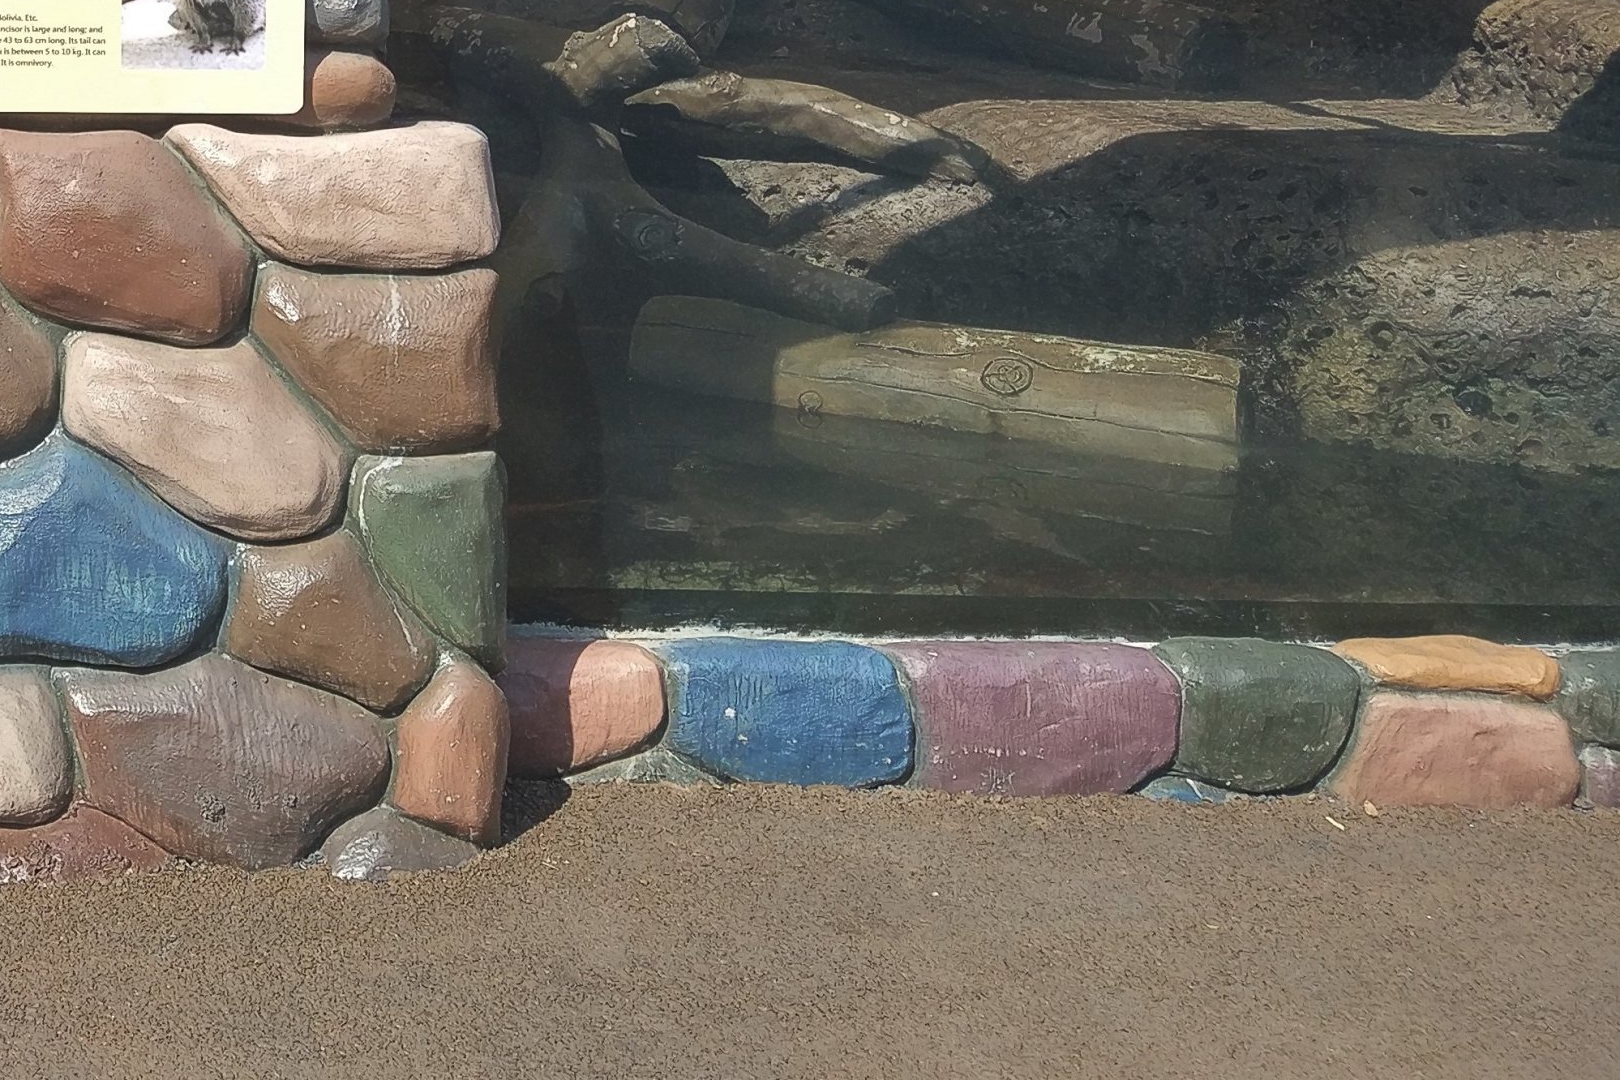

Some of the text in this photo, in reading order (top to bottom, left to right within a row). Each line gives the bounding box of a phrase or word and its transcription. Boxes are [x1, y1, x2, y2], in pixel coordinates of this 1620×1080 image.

[32, 26, 50, 34] large
[68, 36, 78, 44] Its
[80, 36, 92, 44] tail
[0, 58, 6, 66] It
[8, 58, 14, 66] is
